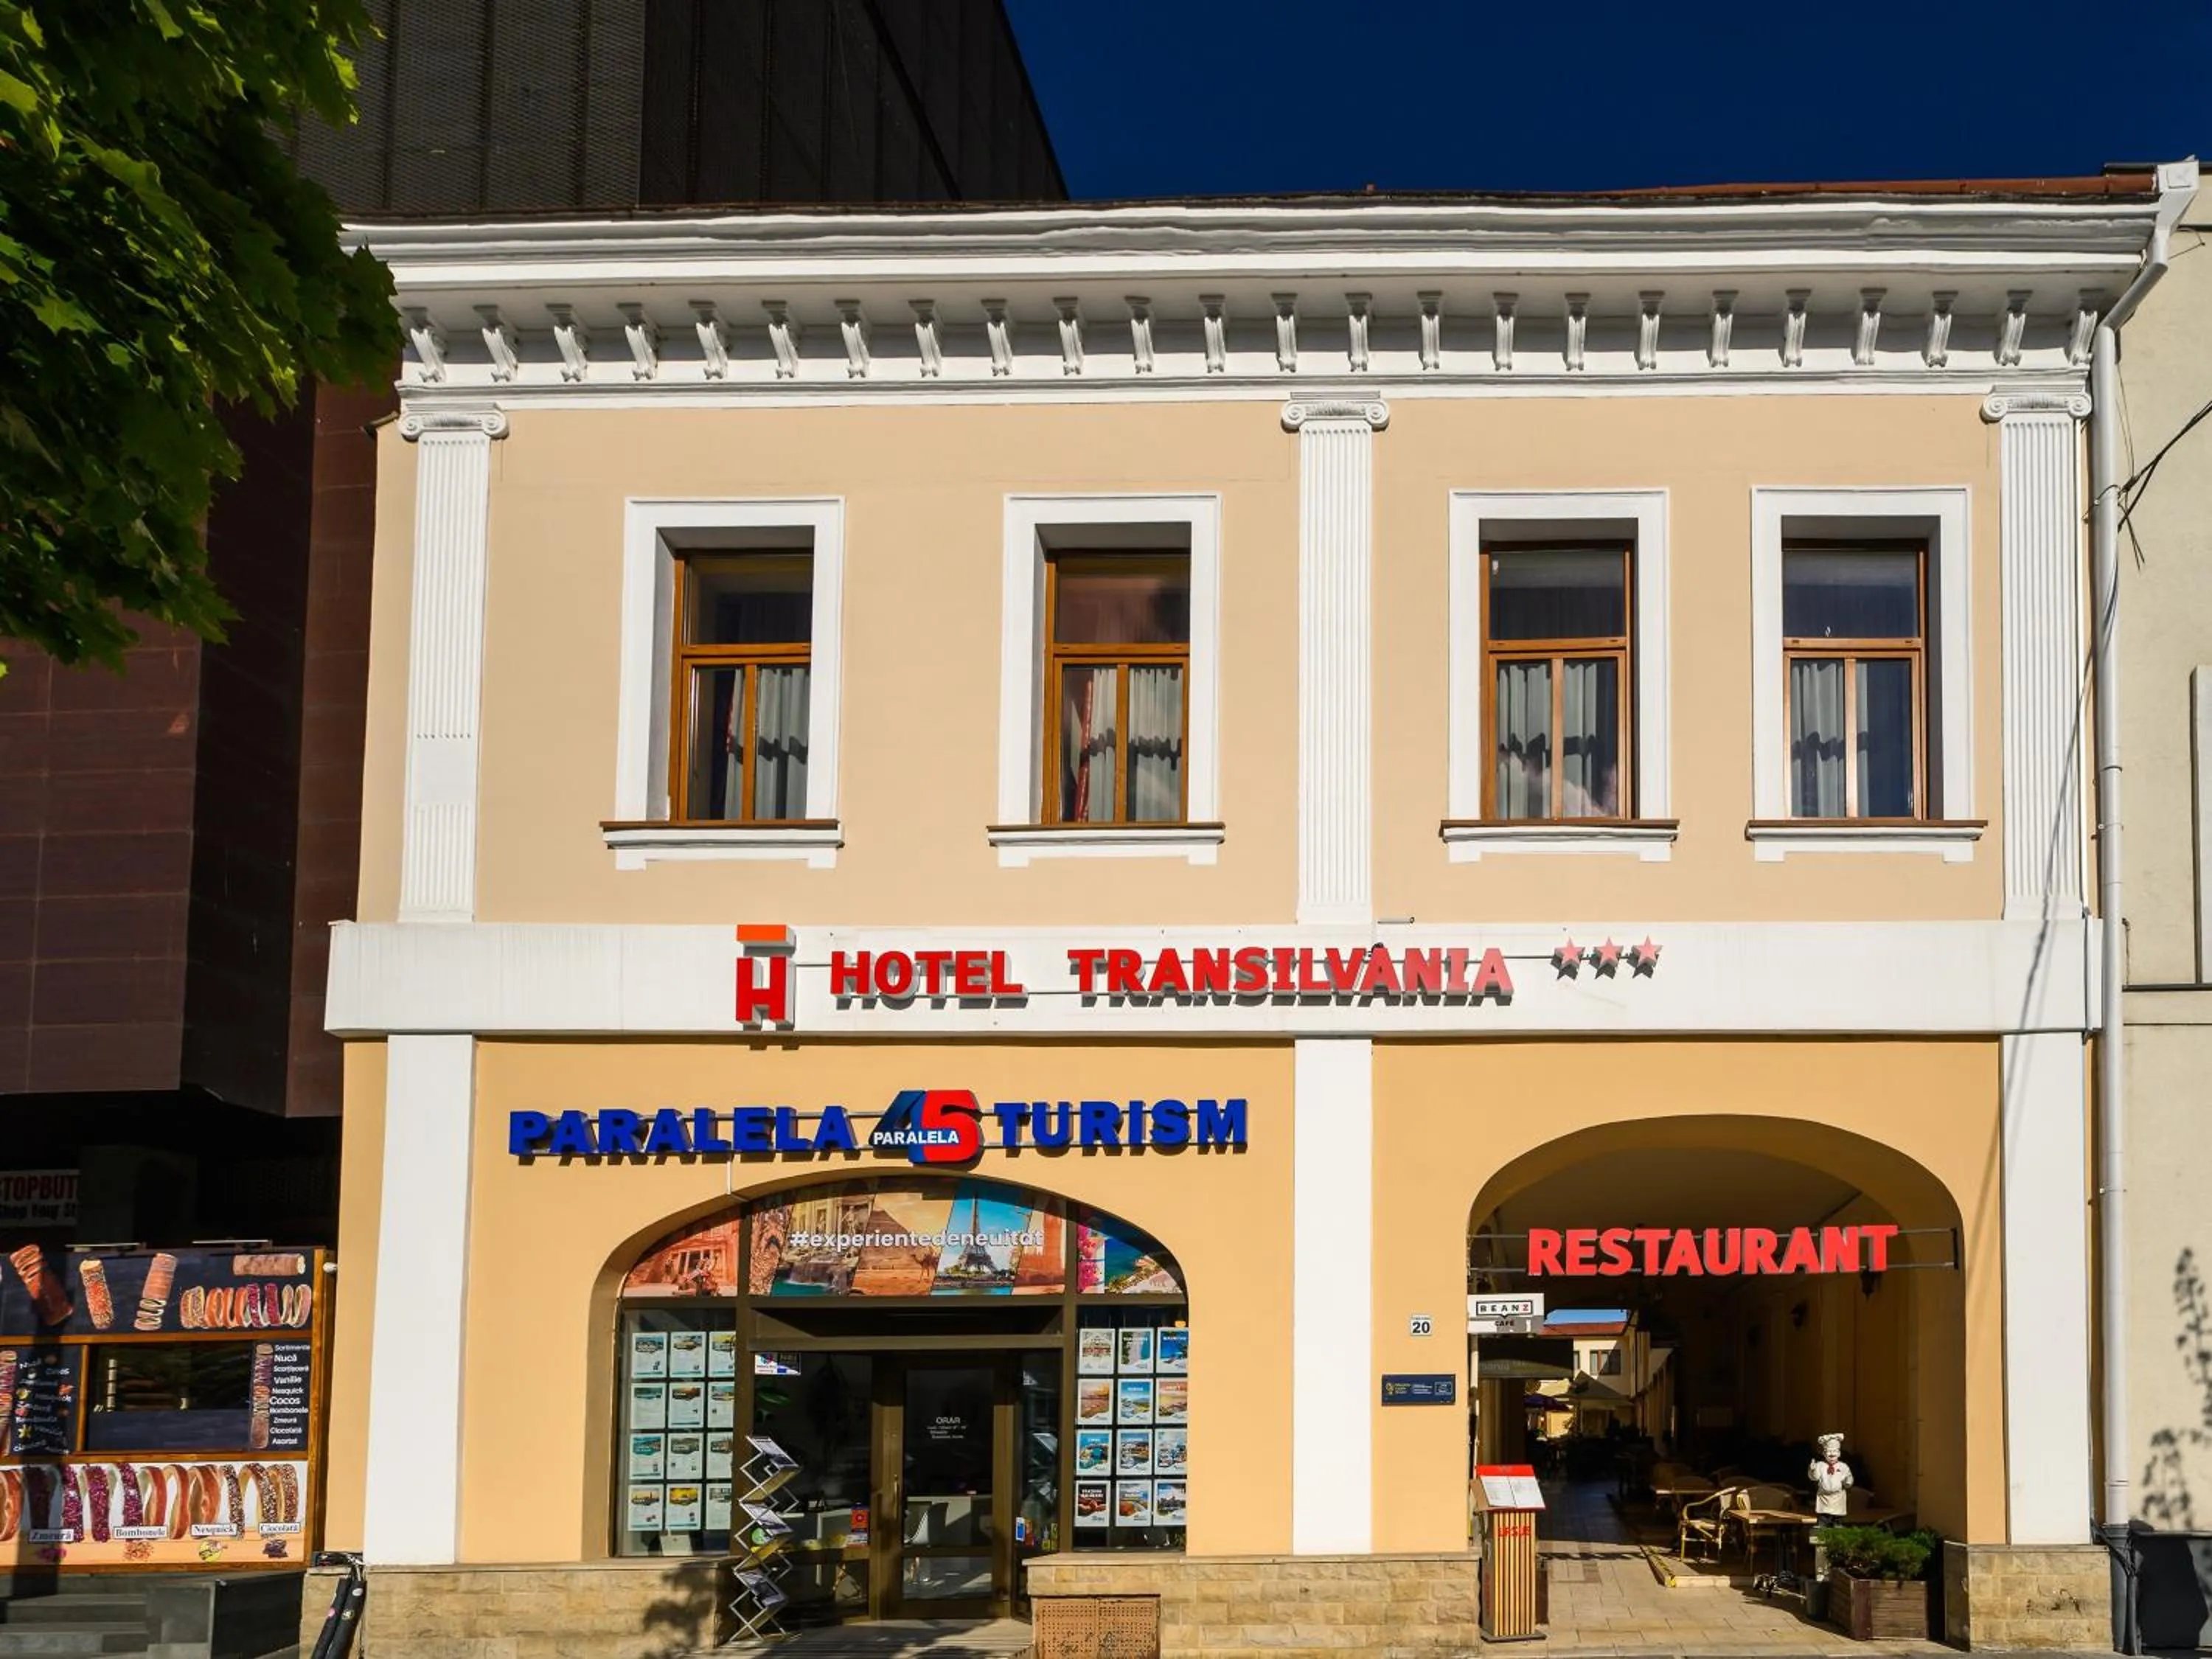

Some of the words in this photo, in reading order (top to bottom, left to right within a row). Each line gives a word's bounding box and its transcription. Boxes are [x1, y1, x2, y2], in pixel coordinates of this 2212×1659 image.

[830, 950, 1024, 997] HOTEL
[1068, 947, 1514, 995] TRANSILVANIA
[509, 1105, 856, 1154] PARALELA
[993, 1099, 1248, 1147] TURISM
[873, 1130, 959, 1145] PARALELA
[1527, 1225, 1899, 1276] RESTAURANT
[1479, 1304, 1528, 1312] BEANZ
[1412, 1321, 1430, 1334] 20
[269, 1397, 301, 1405] Cocos
